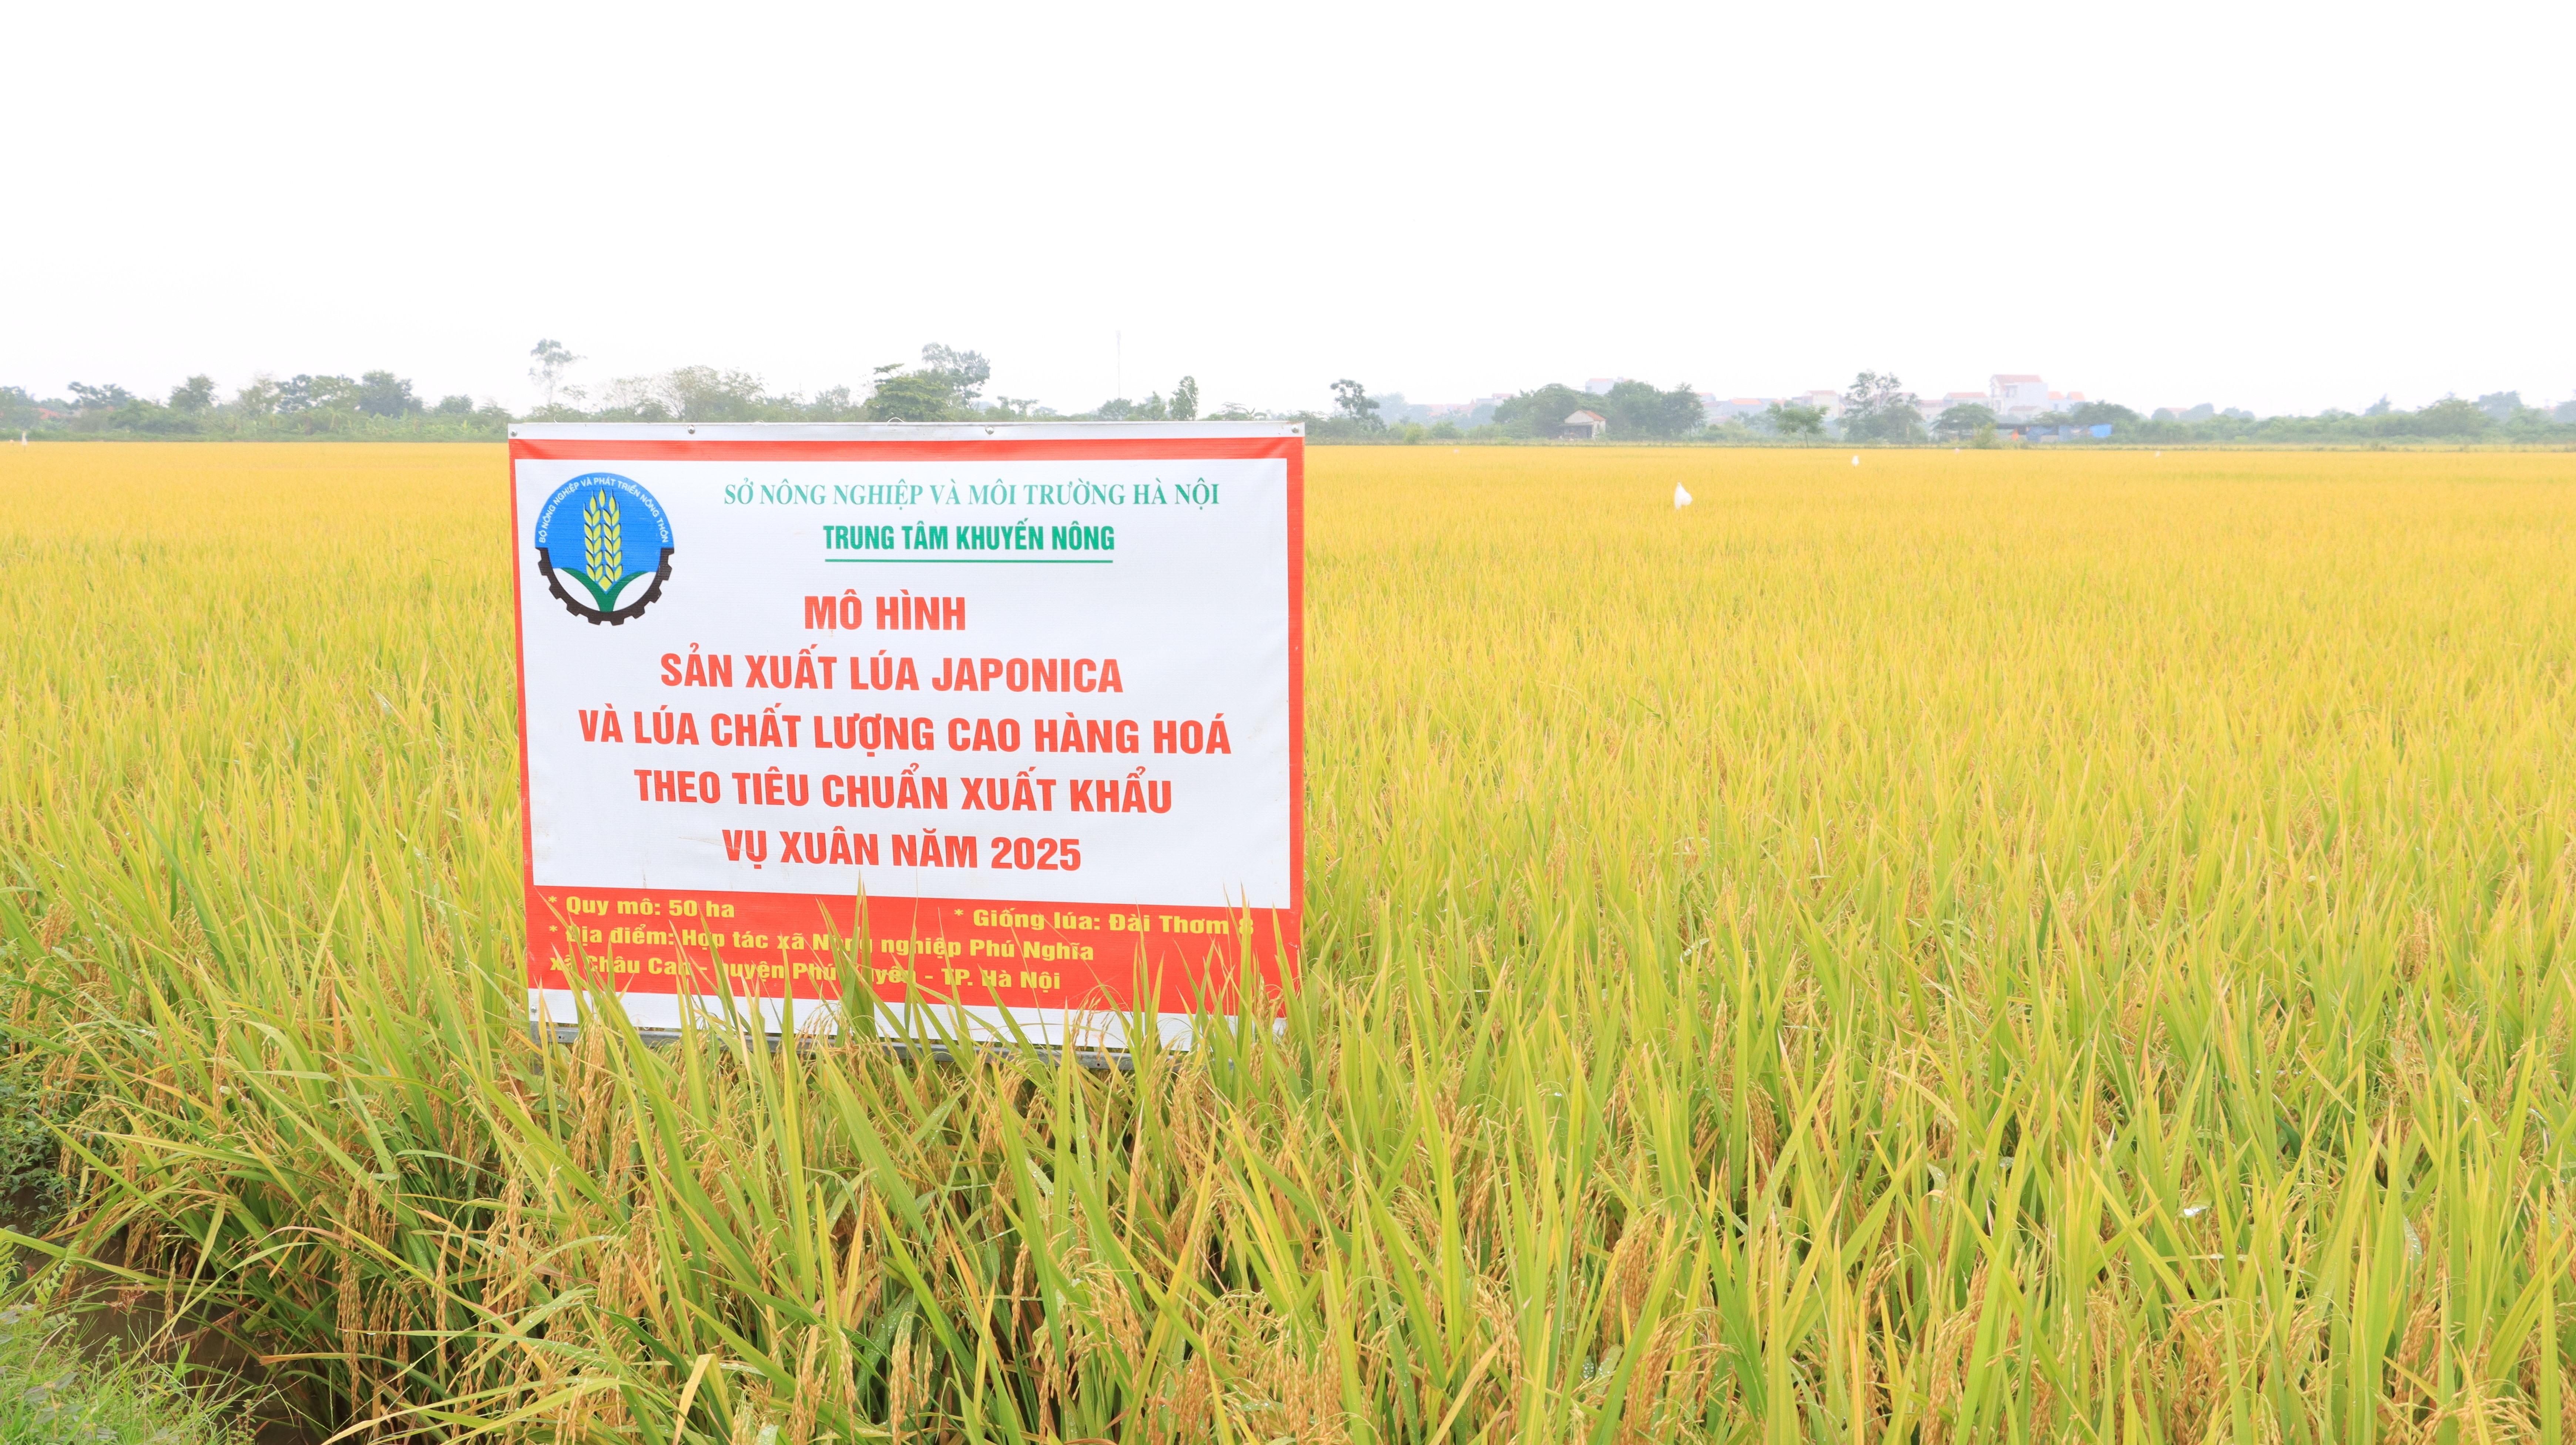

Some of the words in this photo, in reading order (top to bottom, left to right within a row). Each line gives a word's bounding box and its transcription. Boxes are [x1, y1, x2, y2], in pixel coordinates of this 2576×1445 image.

[580, 477, 592, 487] VÀ
[593, 476, 616, 486] PHÁT
[724, 477, 754, 505] SỞ
[761, 478, 826, 505] NÔNG
[833, 479, 923, 510] NGHIỆP
[929, 479, 961, 505] VÀ
[968, 478, 1016, 505] MÔI
[1024, 477, 1126, 505] TRƯỜNG
[1133, 477, 1167, 504] HÀ
[1174, 477, 1220, 510] NỘI
[541, 504, 556, 529] NÔNG
[657, 517, 669, 543] THÔN
[538, 530, 548, 543] BỘ
[823, 525, 895, 550] TRUNG
[901, 520, 949, 550] TÂM
[956, 518, 1044, 550] KHUYẾN
[1052, 520, 1115, 551] NÔNG
[805, 589, 862, 630] MÔ
[876, 589, 966, 630] HÌNH
[661, 643, 732, 688] SẢN
[745, 643, 837, 690] XUẤT
[850, 650, 919, 691] LÚA
[932, 658, 1123, 693] JAPONICA
[578, 703, 623, 743] VÀ
[634, 705, 699, 745] LÚA
[711, 703, 801, 747] CHẤT
[814, 713, 935, 757] LƯỢNG
[948, 718, 1020, 752] CAO
[1035, 712, 1139, 754] HÀNG
[1154, 713, 1231, 755] HOÁ
[634, 770, 721, 804] THEO
[732, 766, 809, 807] TIÊU
[822, 762, 947, 809] CHUẨN
[961, 766, 1056, 811] XUẤT
[1070, 766, 1172, 814] KHẨU
[722, 829, 767, 870] VỤ
[780, 826, 879, 866] XUÂN
[892, 828, 977, 868] NĂM
[991, 837, 1081, 871] 2025
[566, 896, 609, 916] Quy
[617, 898, 661, 915] mô:
[669, 899, 697, 916] 50
[706, 901, 735, 918] ha
[973, 908, 1045, 931] Giống
[1054, 912, 1100, 930] lúa:
[1108, 913, 1150, 932] Đài
[1159, 915, 1229, 934] Thơm
[610, 924, 674, 945] điểm:
[682, 929, 725, 950] Hợp
[732, 931, 768, 948] tác
[777, 933, 805, 950] xã
[881, 938, 961, 959] nghiệp
[970, 939, 1015, 958] Phú
[1023, 941, 1094, 961] Nghĩa
[793, 963, 836, 980] Phú
[941, 968, 973, 986] TP.
[982, 970, 1012, 987] Hà
[1020, 971, 1060, 992] Nội
